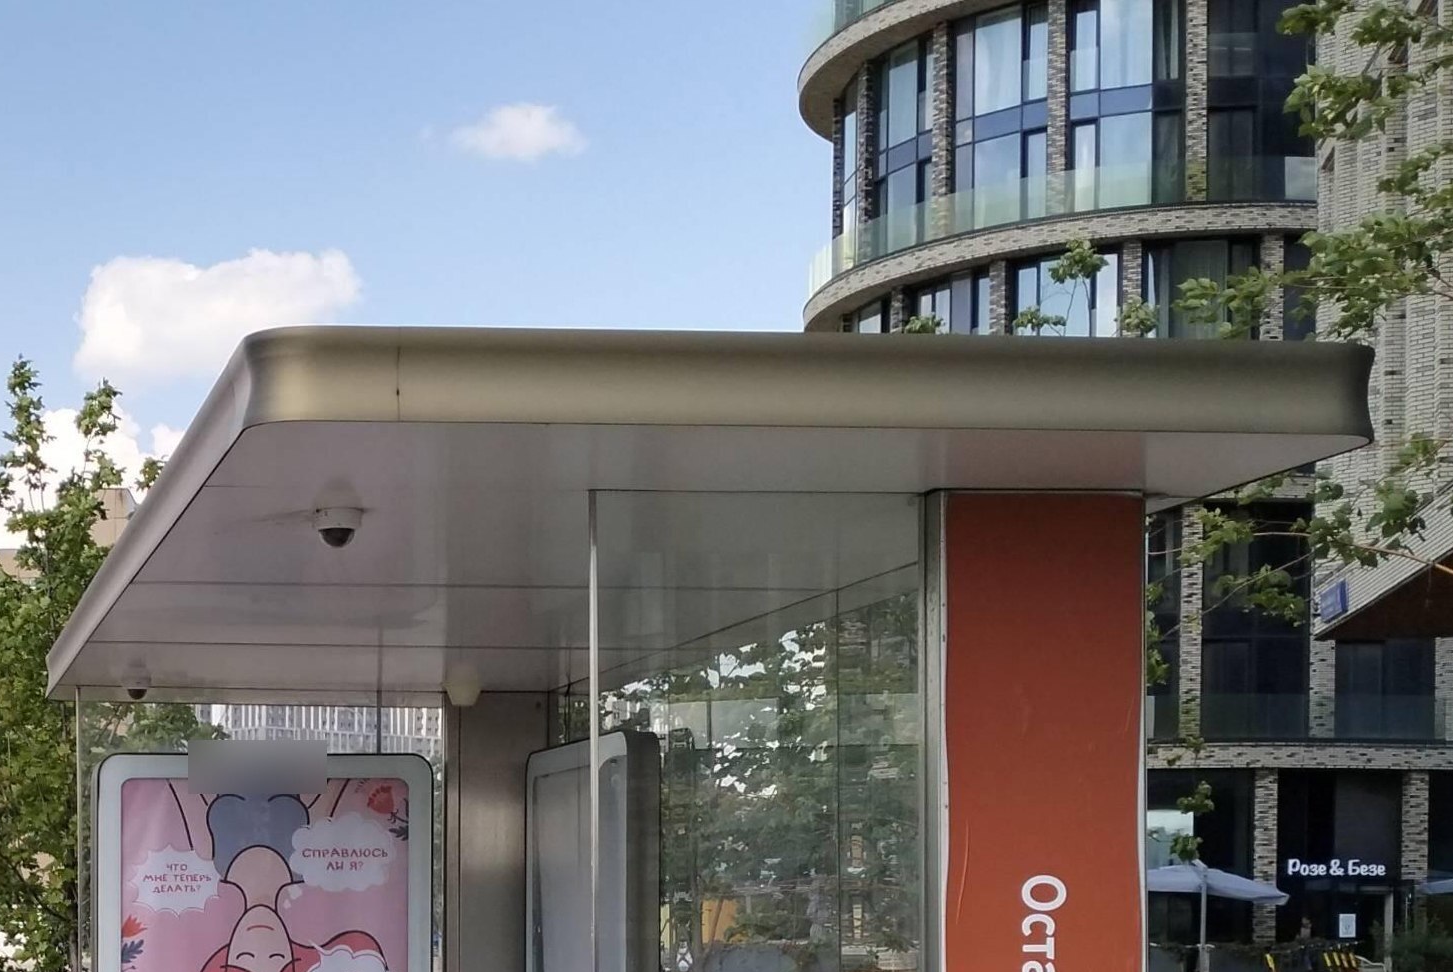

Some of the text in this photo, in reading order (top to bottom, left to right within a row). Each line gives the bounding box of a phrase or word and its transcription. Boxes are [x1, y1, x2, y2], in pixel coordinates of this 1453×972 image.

[301, 847, 389, 858] СПРАВЛЮСЬ
[166, 863, 188, 872] ЧТО
[326, 861, 364, 871] ЛИ Я?
[1287, 858, 1387, 876] Розе & Безе
[143, 873, 212, 882] МНЕ ТЕПЕРЬ
[152, 884, 202, 894] ДЕЛАТЬ?
